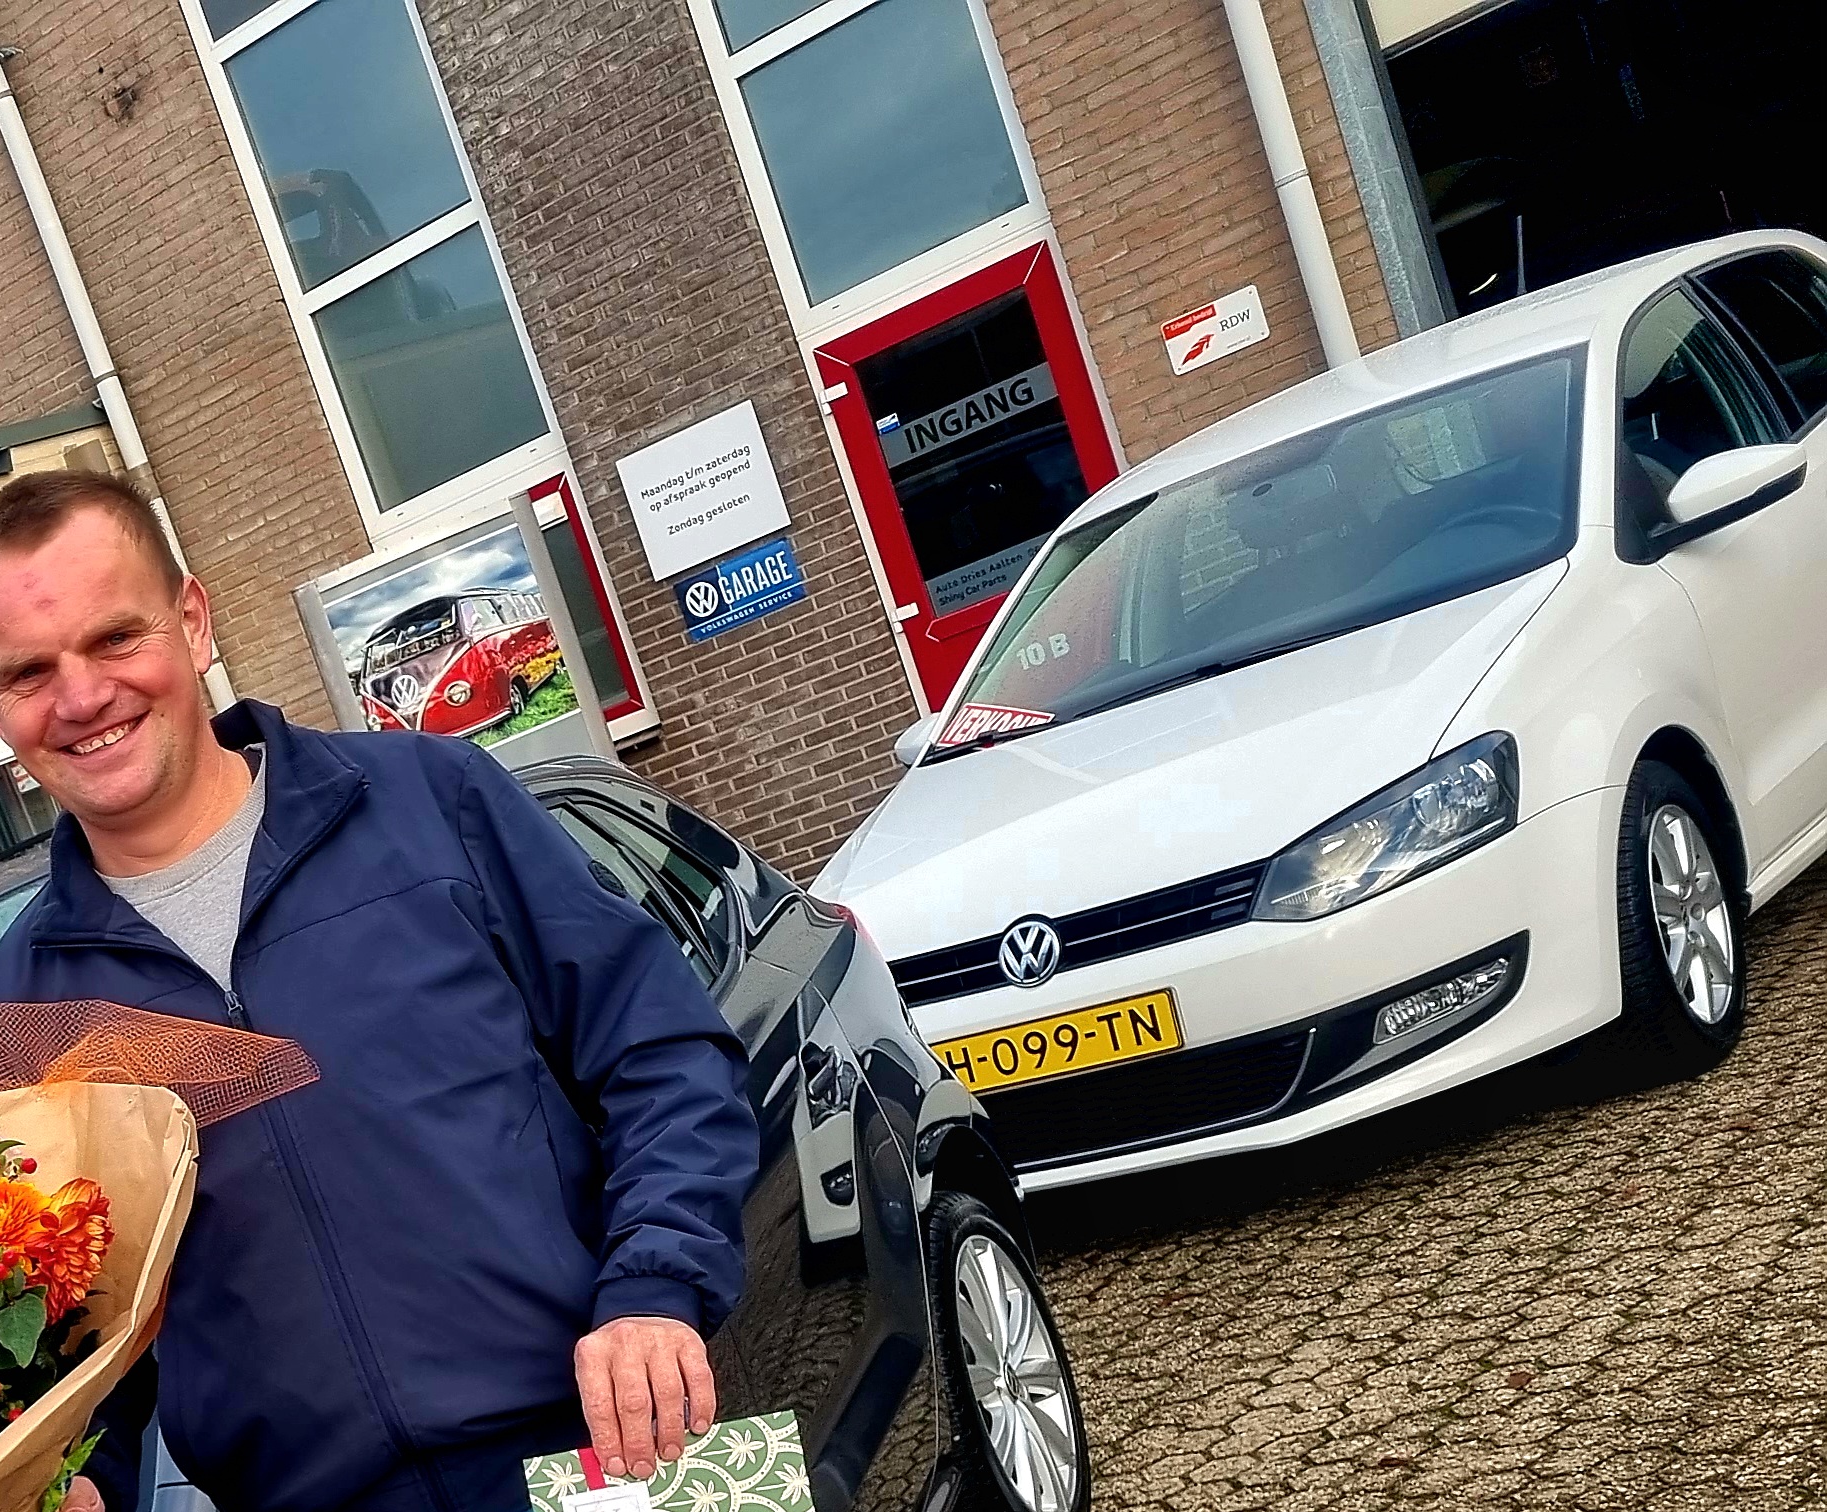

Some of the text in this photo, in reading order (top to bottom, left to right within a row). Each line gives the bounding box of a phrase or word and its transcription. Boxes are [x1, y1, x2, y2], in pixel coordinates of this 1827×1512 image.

[1219, 309, 1250, 331] RDW
[904, 377, 1035, 453] INGANG
[641, 445, 751, 499] Maandag t/m zaterdag
[650, 458, 751, 512] op afspraak geopend
[667, 494, 750, 535] Zondag gesloten
[717, 550, 793, 605] GARAGE
[938, 573, 1007, 606] Shiny Car Parts
[960, 570, 987, 584] Dries
[989, 554, 1023, 573] Aalten
[700, 591, 792, 634] VOLKSWAGEN SERVICE
[1016, 633, 1071, 671] 10 B
